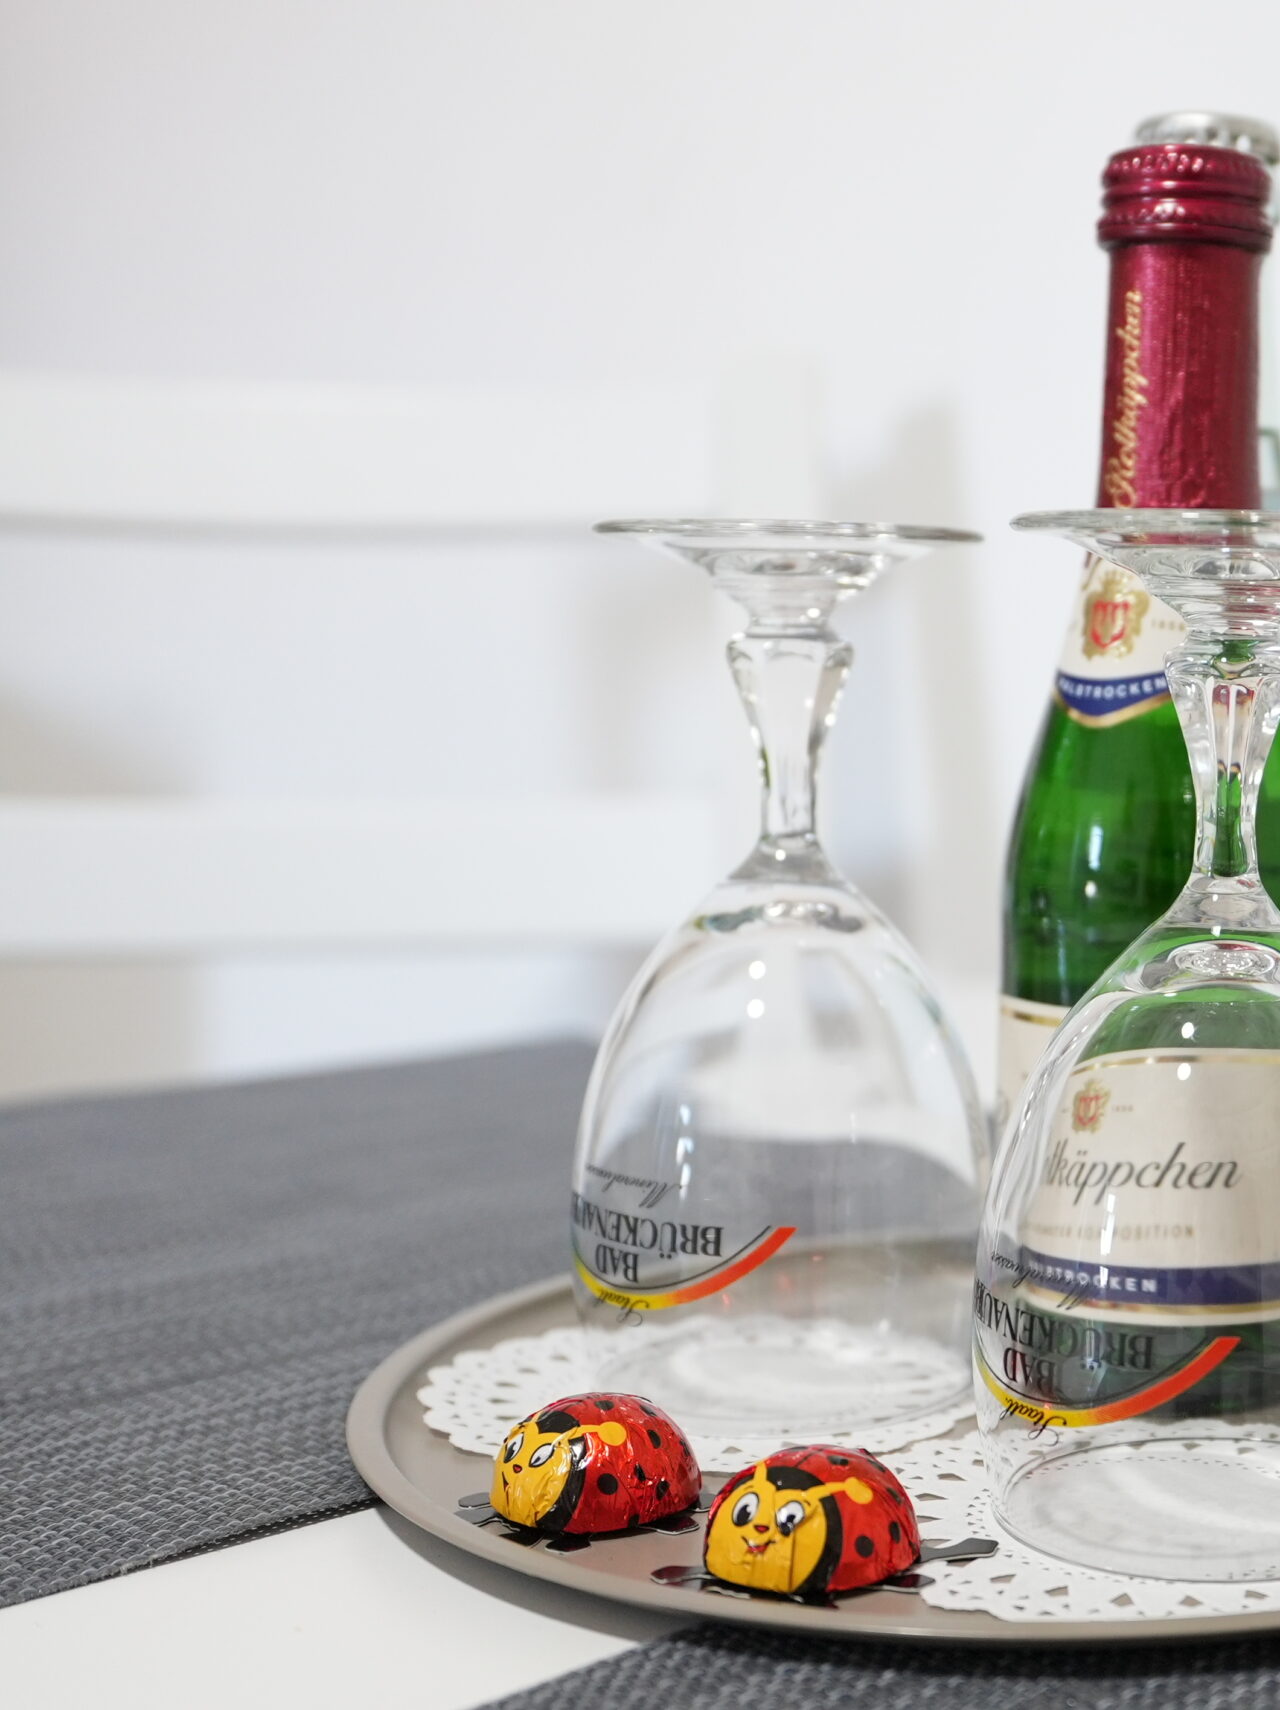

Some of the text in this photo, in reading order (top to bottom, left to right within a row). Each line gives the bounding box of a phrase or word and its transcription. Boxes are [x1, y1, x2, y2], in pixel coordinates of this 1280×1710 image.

[1046, 1138, 1243, 1206] tkäppchen
[595, 1243, 639, 1283] BAD
[1003, 1347, 1057, 1397] BAD
